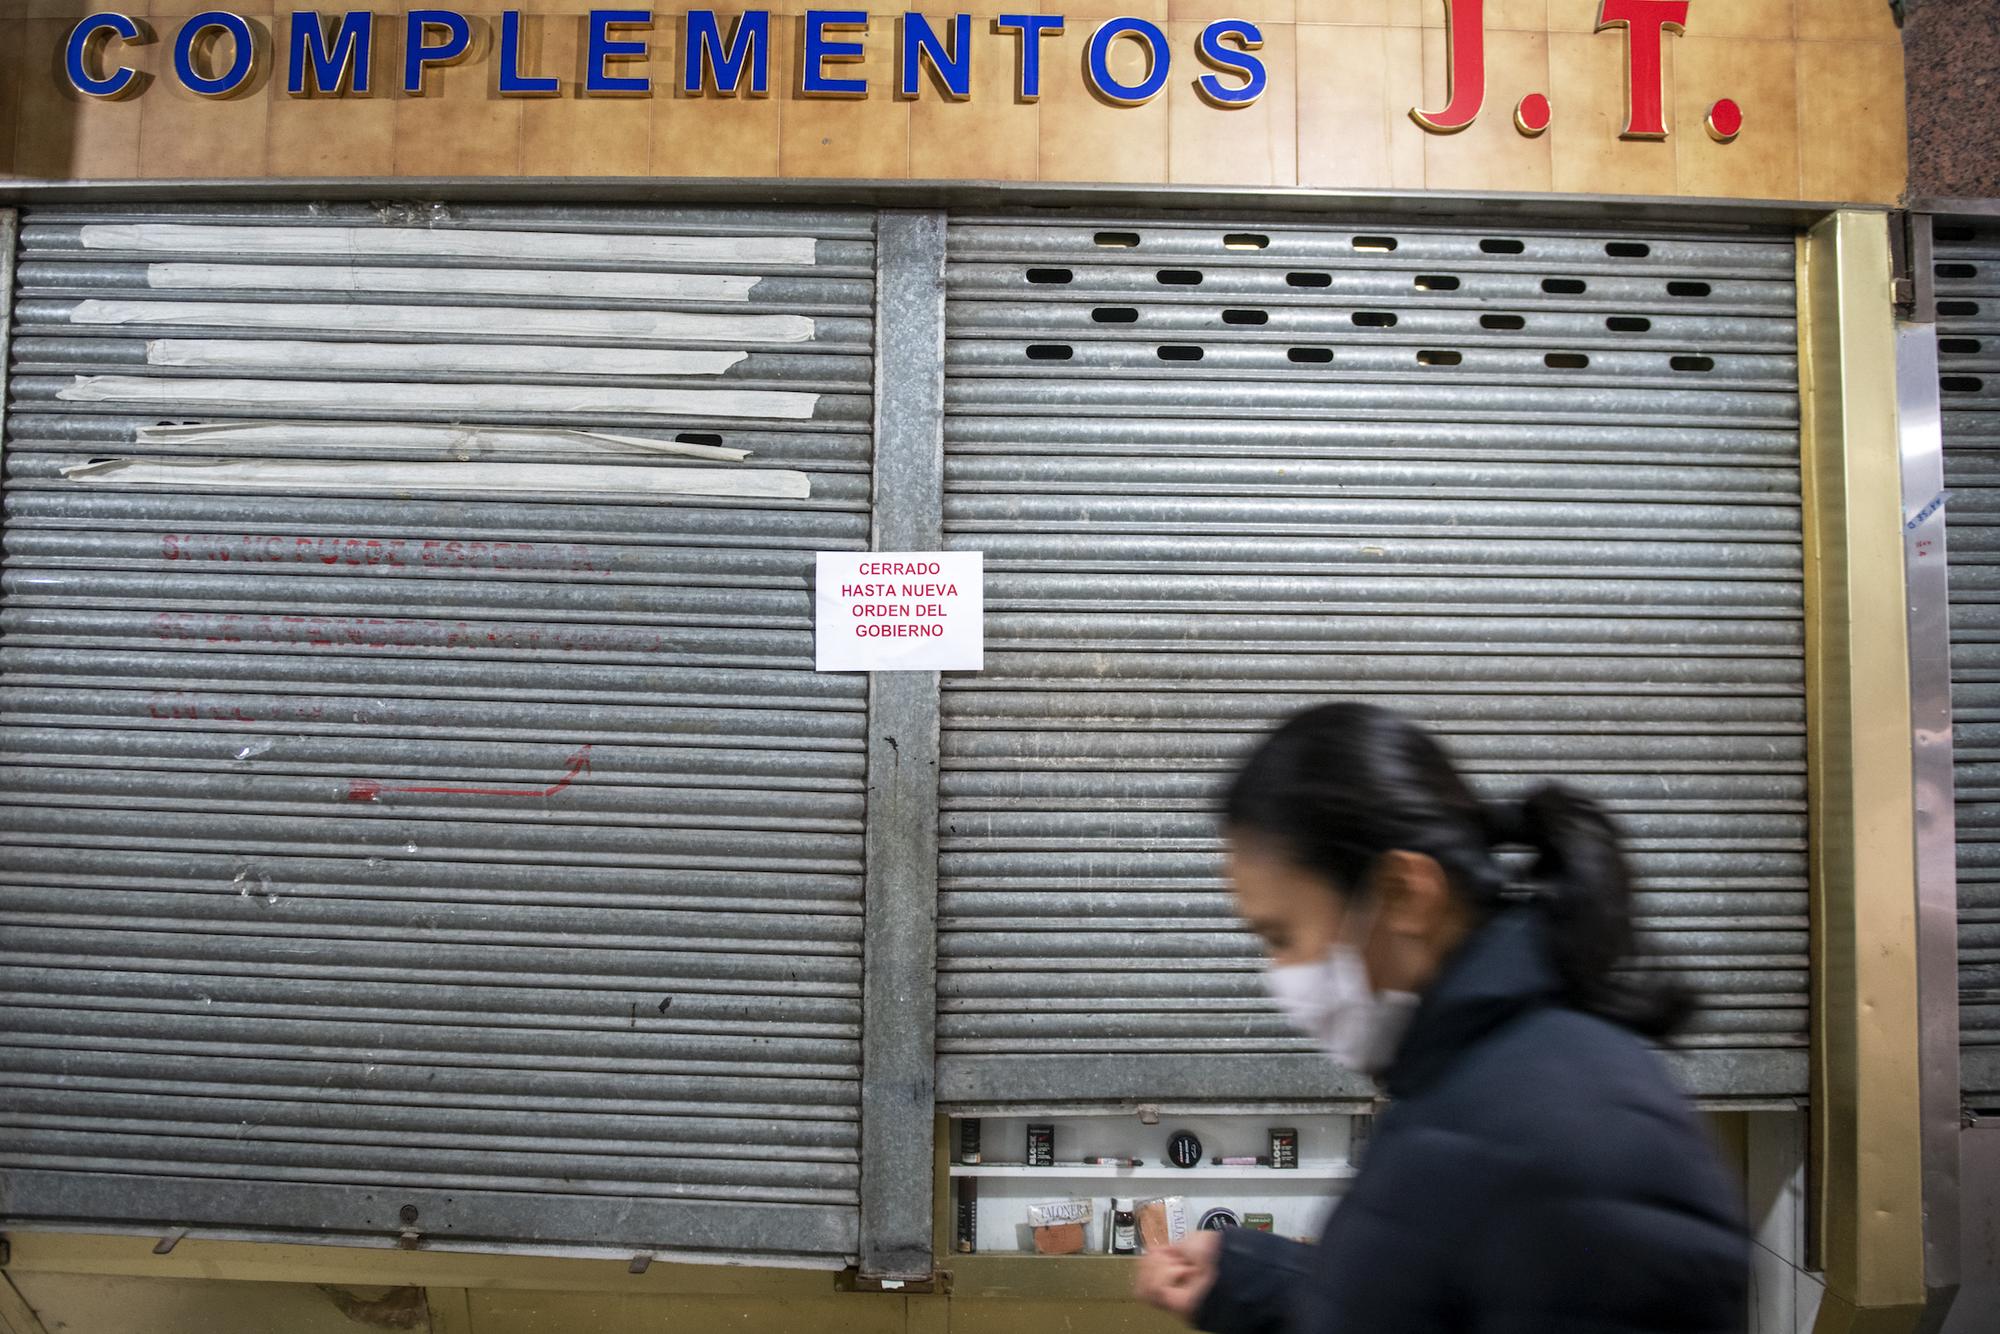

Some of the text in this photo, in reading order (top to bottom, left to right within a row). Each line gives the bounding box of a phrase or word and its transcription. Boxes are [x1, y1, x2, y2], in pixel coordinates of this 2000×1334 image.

[64, 9, 1269, 108] COMPLEMENTOS
[859, 563, 940, 575] CERRADO
[842, 584, 958, 597] HASTA NUEVA
[852, 604, 947, 617] ORDEN DEL
[855, 624, 944, 637] GOBIERNO
[1028, 1135, 1037, 1165] BLOCK
